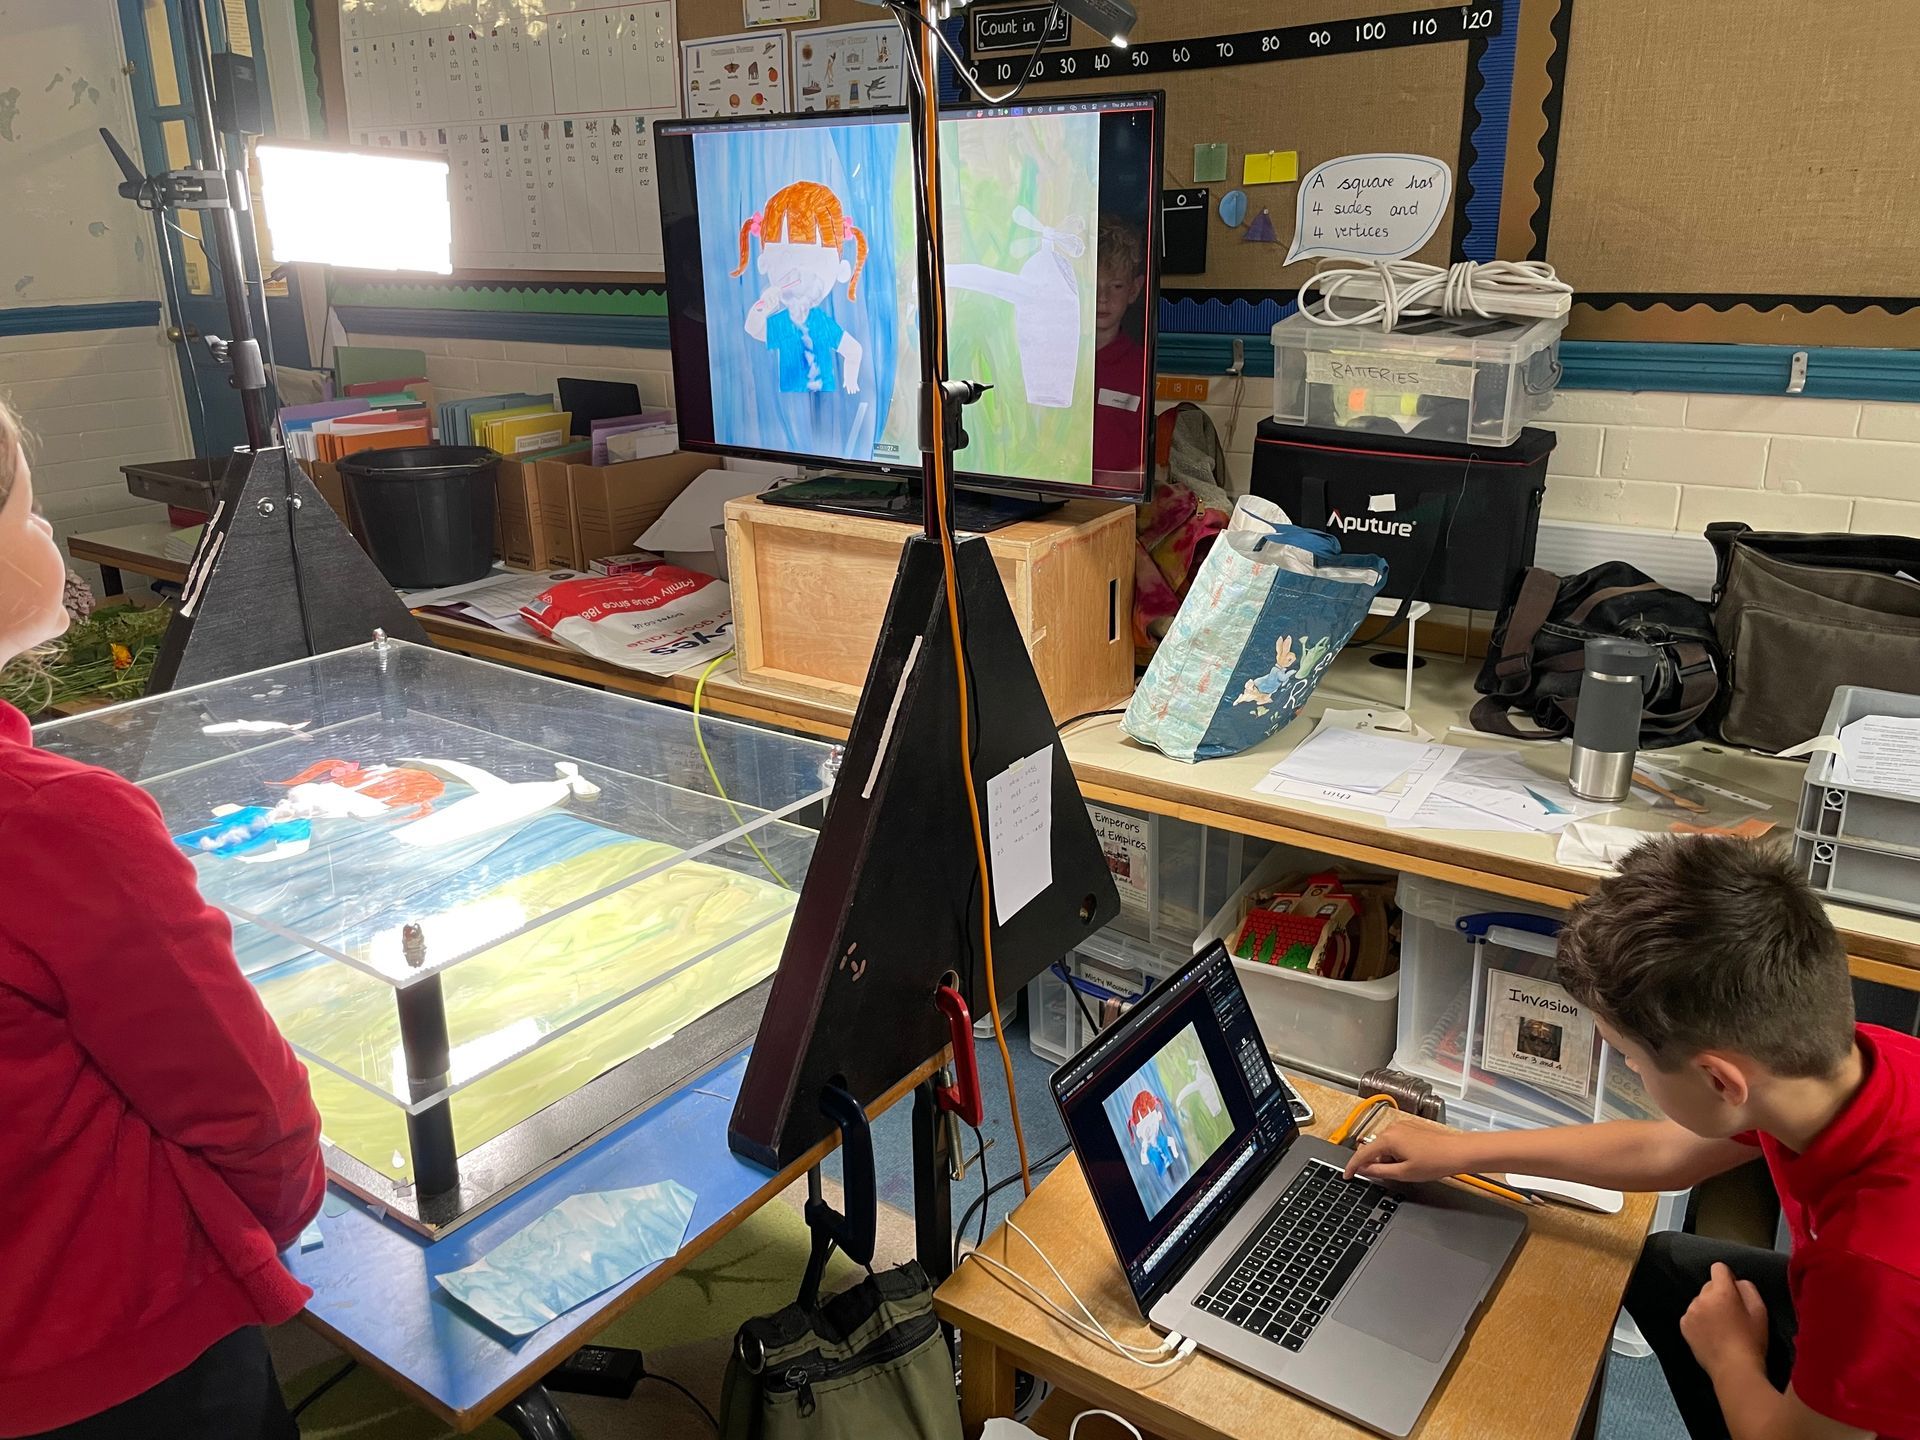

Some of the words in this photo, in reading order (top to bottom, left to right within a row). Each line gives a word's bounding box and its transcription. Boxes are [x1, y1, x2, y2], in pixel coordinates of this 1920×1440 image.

[980, 19, 1018, 36] Count
[1023, 17, 1035, 32] in
[998, 64, 1011, 80] 10
[1060, 57, 1076, 74] 30
[1095, 53, 1110, 71] 40
[1132, 52, 1149, 67] 50
[1172, 46, 1190, 63] 60
[1216, 43, 1234, 58] 70
[1262, 35, 1280, 52] 80
[1309, 30, 1331, 47] 90
[1355, 22, 1386, 42] 100
[1412, 18, 1437, 36] 110
[1462, 9, 1492, 30] 120
[1313, 174, 1325, 188] A
[1337, 177, 1394, 198] square
[1405, 175, 1434, 189] has
[1313, 201, 1323, 215] 4
[1334, 200, 1372, 216] sides
[1390, 201, 1418, 216] and
[1314, 226, 1323, 238] 4
[1335, 224, 1389, 238] vertices
[1331, 362, 1420, 383] BATTERIES
[1327, 509, 1413, 537] Aputure
[661, 579, 695, 597] family
[602, 600, 632, 610] since
[633, 596, 661, 606] value
[578, 605, 602, 620] 188
[1094, 812, 1140, 833] Emperors
[1094, 828, 1105, 837] nd
[1108, 831, 1147, 850] Empires
[1085, 972, 1104, 986] Misty
[1508, 988, 1578, 1017] Invasion
[1511, 1051, 1529, 1061] Year
[1531, 1056, 1537, 1064] 3
[1540, 1060, 1554, 1069] and
